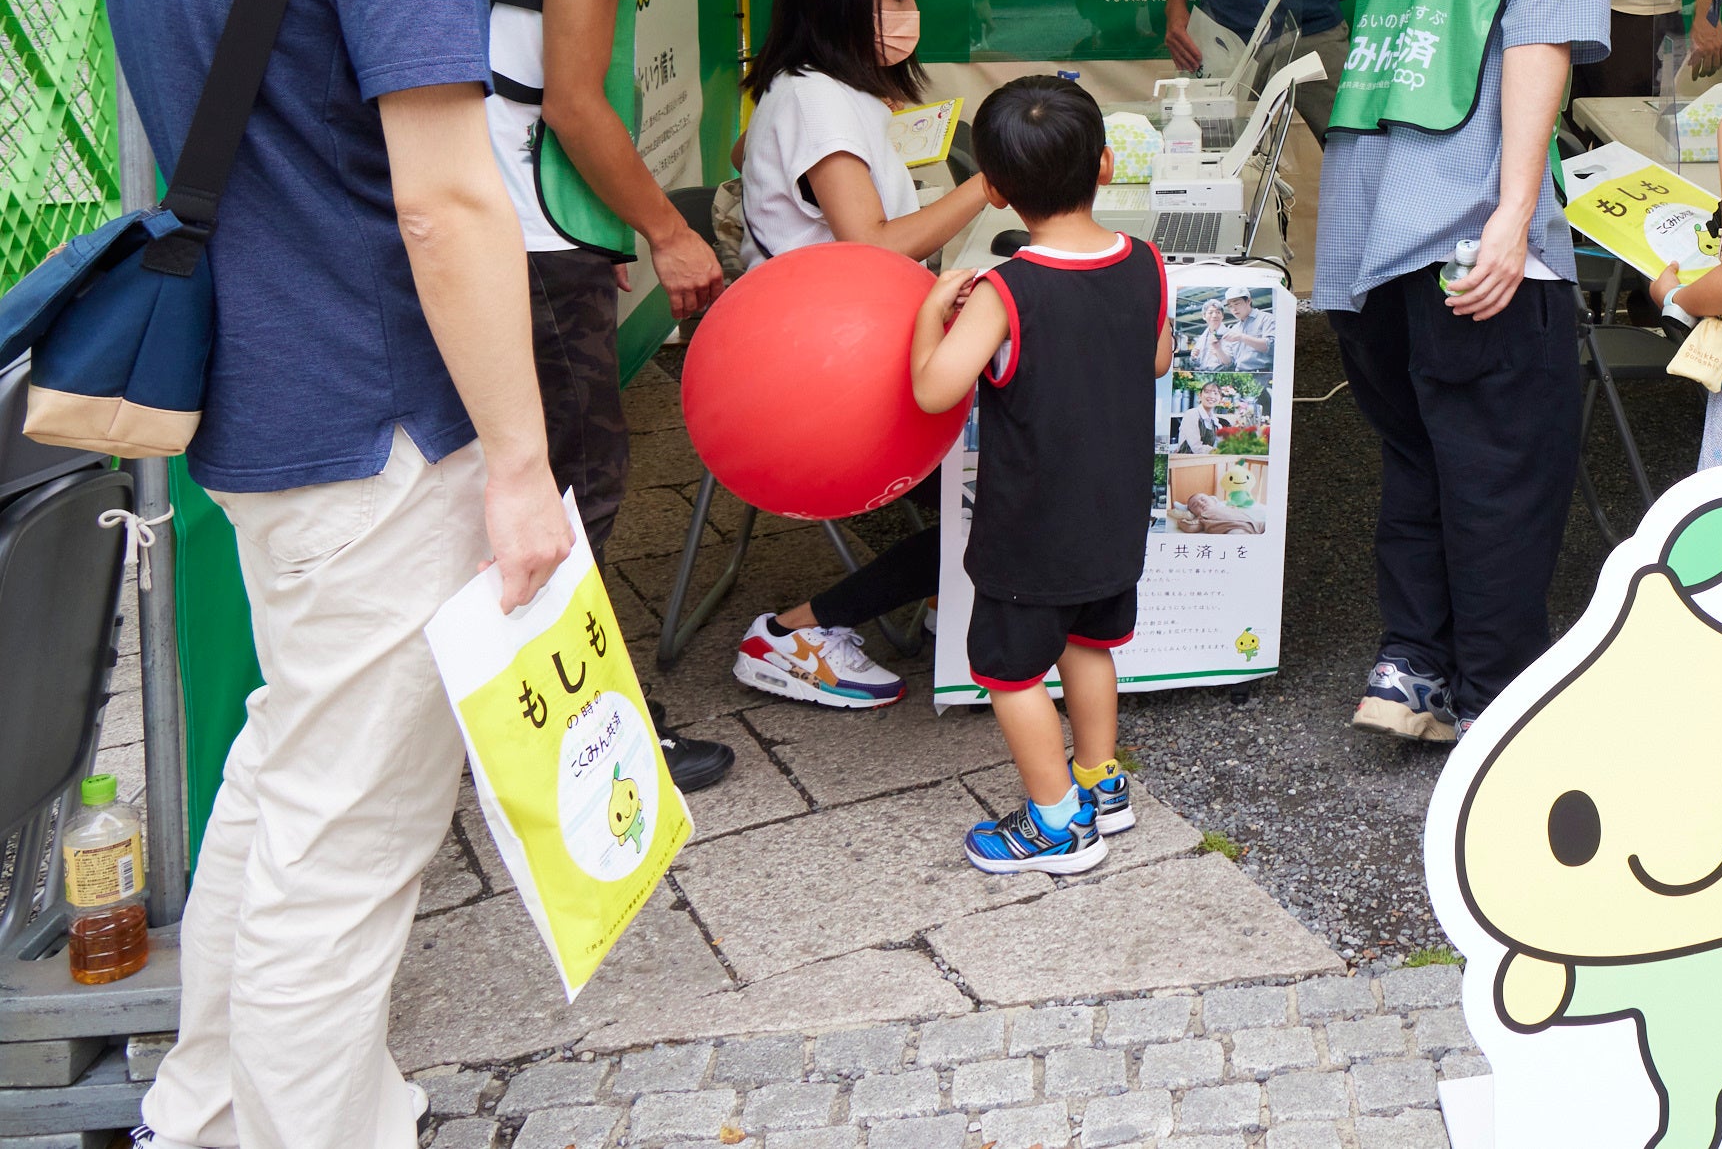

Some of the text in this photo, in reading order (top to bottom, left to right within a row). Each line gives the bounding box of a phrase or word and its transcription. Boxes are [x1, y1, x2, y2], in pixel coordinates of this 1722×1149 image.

[1595, 179, 1671, 218] もしも
[517, 610, 607, 729] もしも
[566, 690, 602, 730] の時の
[571, 710, 622, 778] こくみん共済
